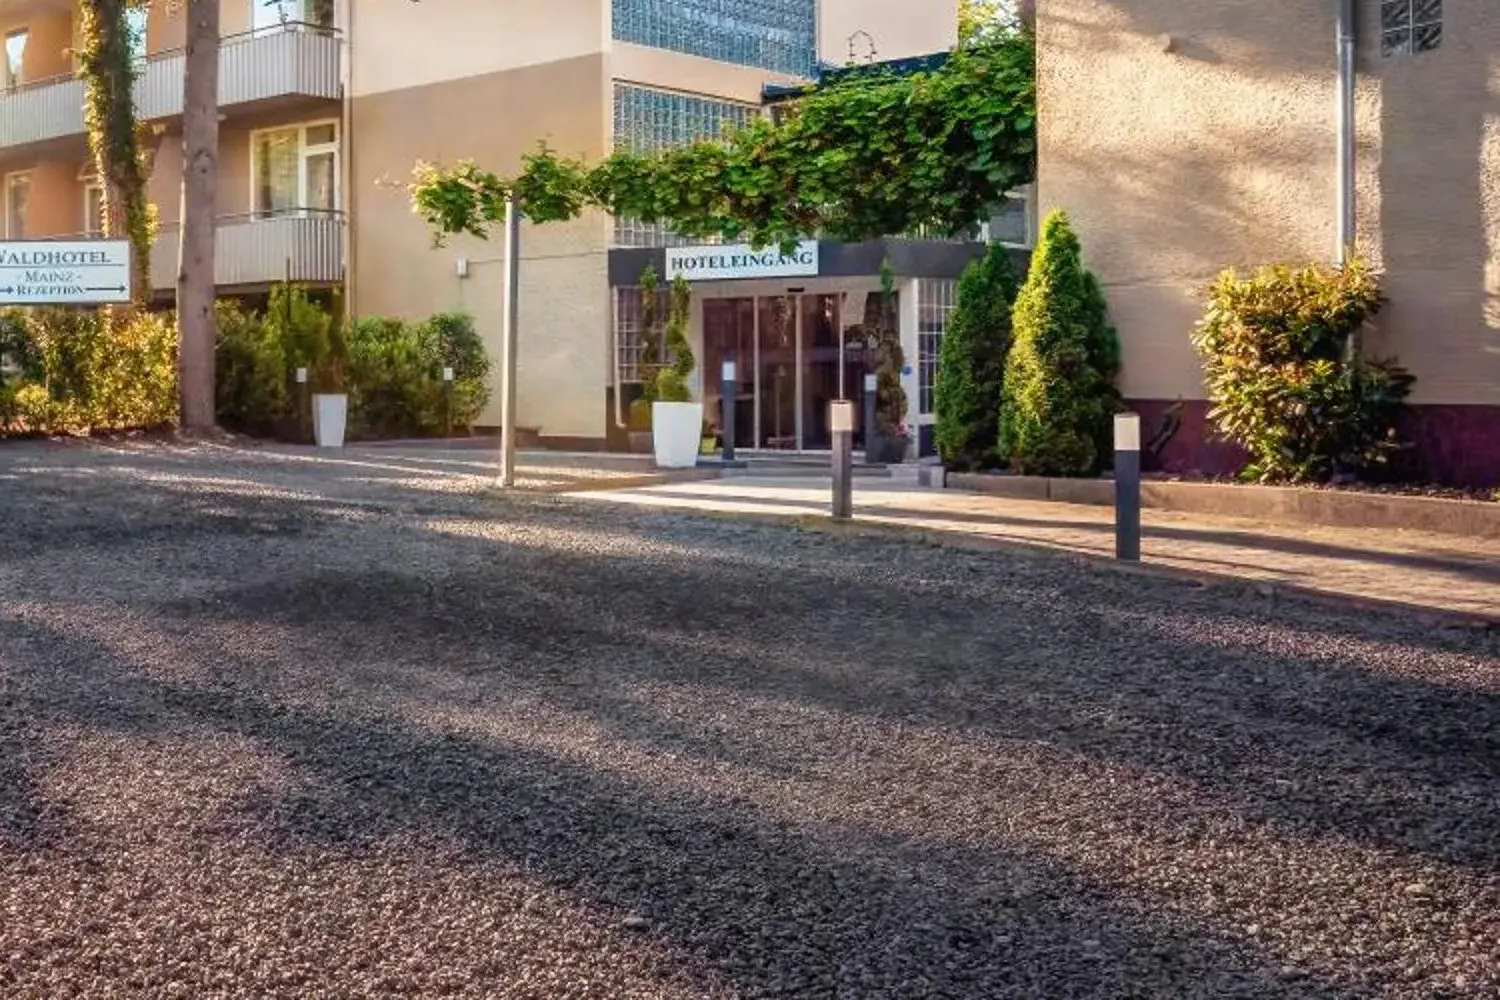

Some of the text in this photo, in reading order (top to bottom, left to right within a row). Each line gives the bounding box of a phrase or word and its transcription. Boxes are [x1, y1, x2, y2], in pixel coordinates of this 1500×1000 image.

[671, 251, 813, 270] HOTELEINGANG
[25, 270, 74, 283] MAINZ
[16, 284, 85, 296] REZEPTION
